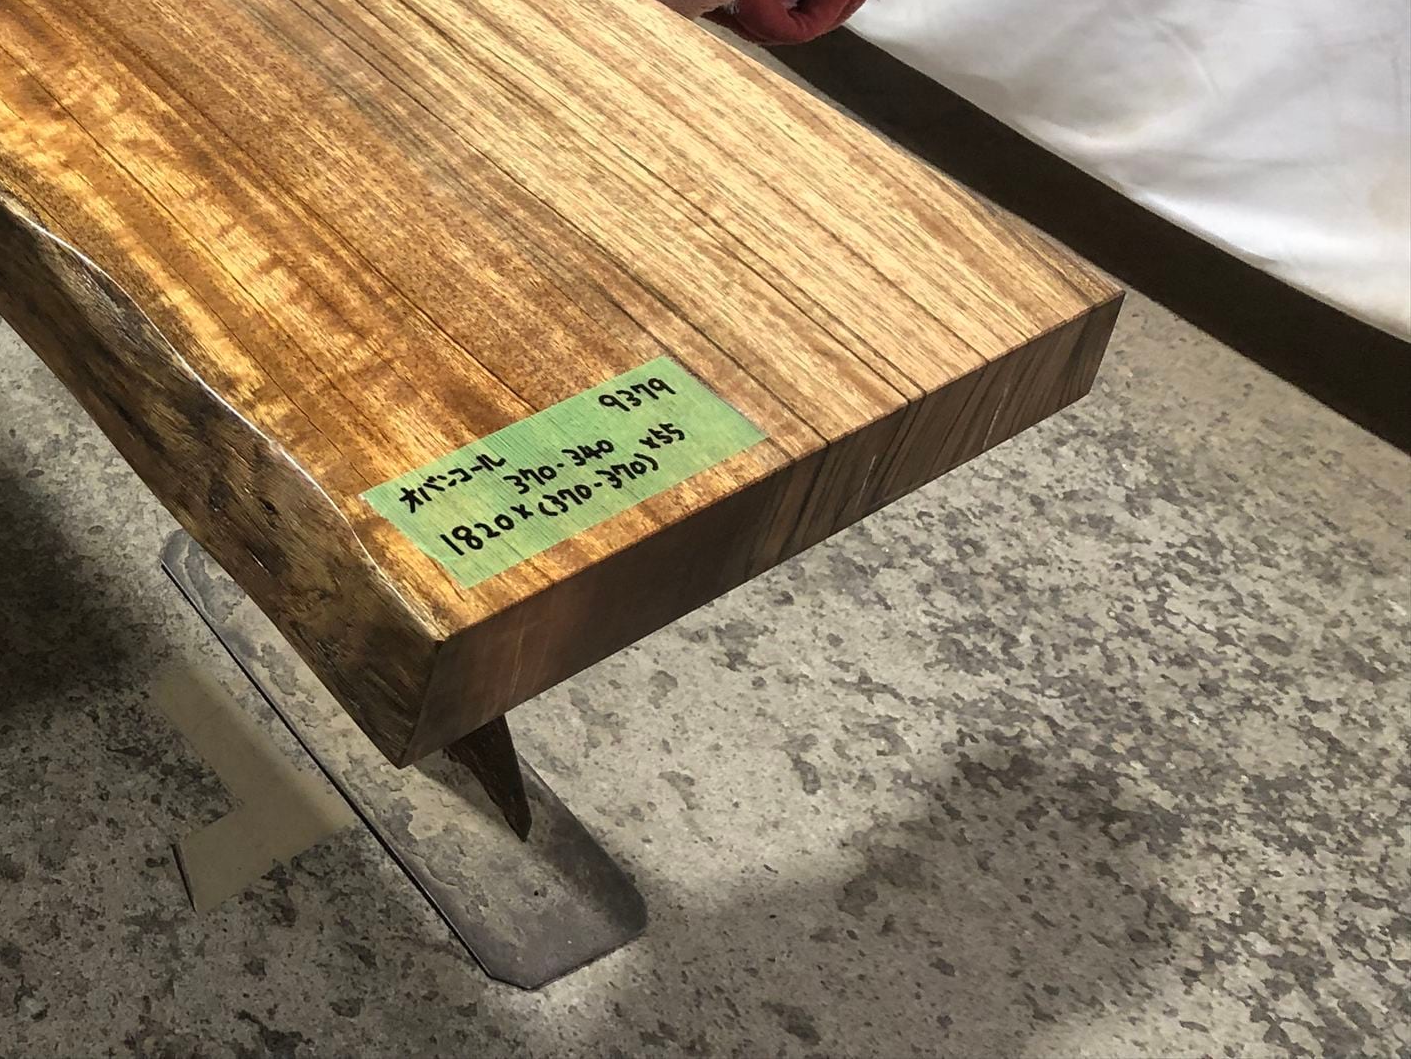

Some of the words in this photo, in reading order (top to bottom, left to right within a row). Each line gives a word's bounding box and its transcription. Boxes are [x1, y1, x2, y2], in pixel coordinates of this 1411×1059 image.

[599, 378, 675, 412] 9379
[398, 454, 507, 513] オバンコール
